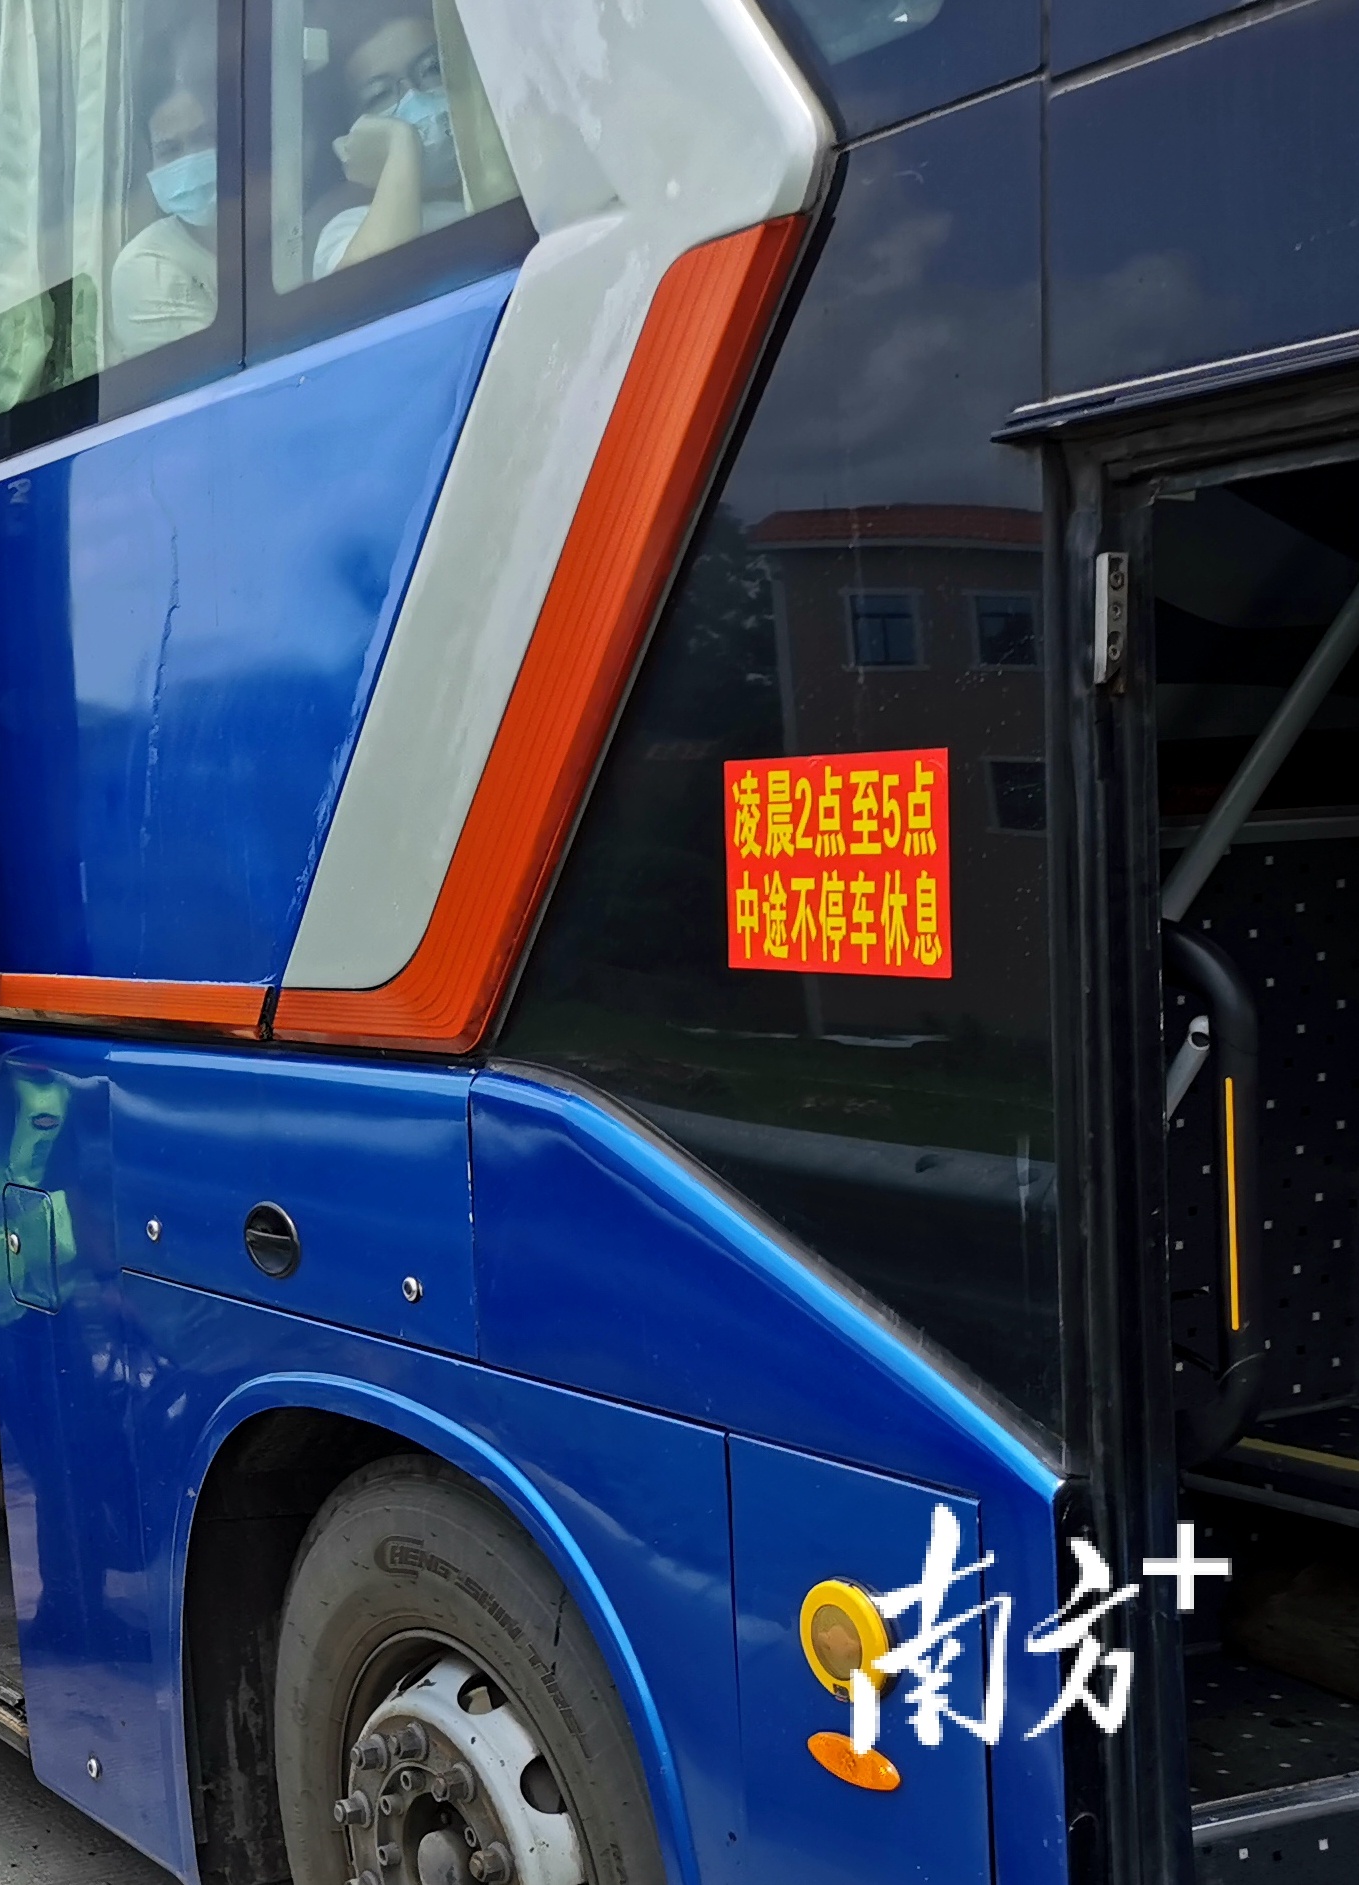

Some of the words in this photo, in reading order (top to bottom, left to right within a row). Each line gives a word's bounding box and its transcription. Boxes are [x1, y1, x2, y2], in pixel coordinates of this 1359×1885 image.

[732, 760, 938, 859] 凌晨2点至5点
[735, 869, 943, 967] 中途不停车休息
